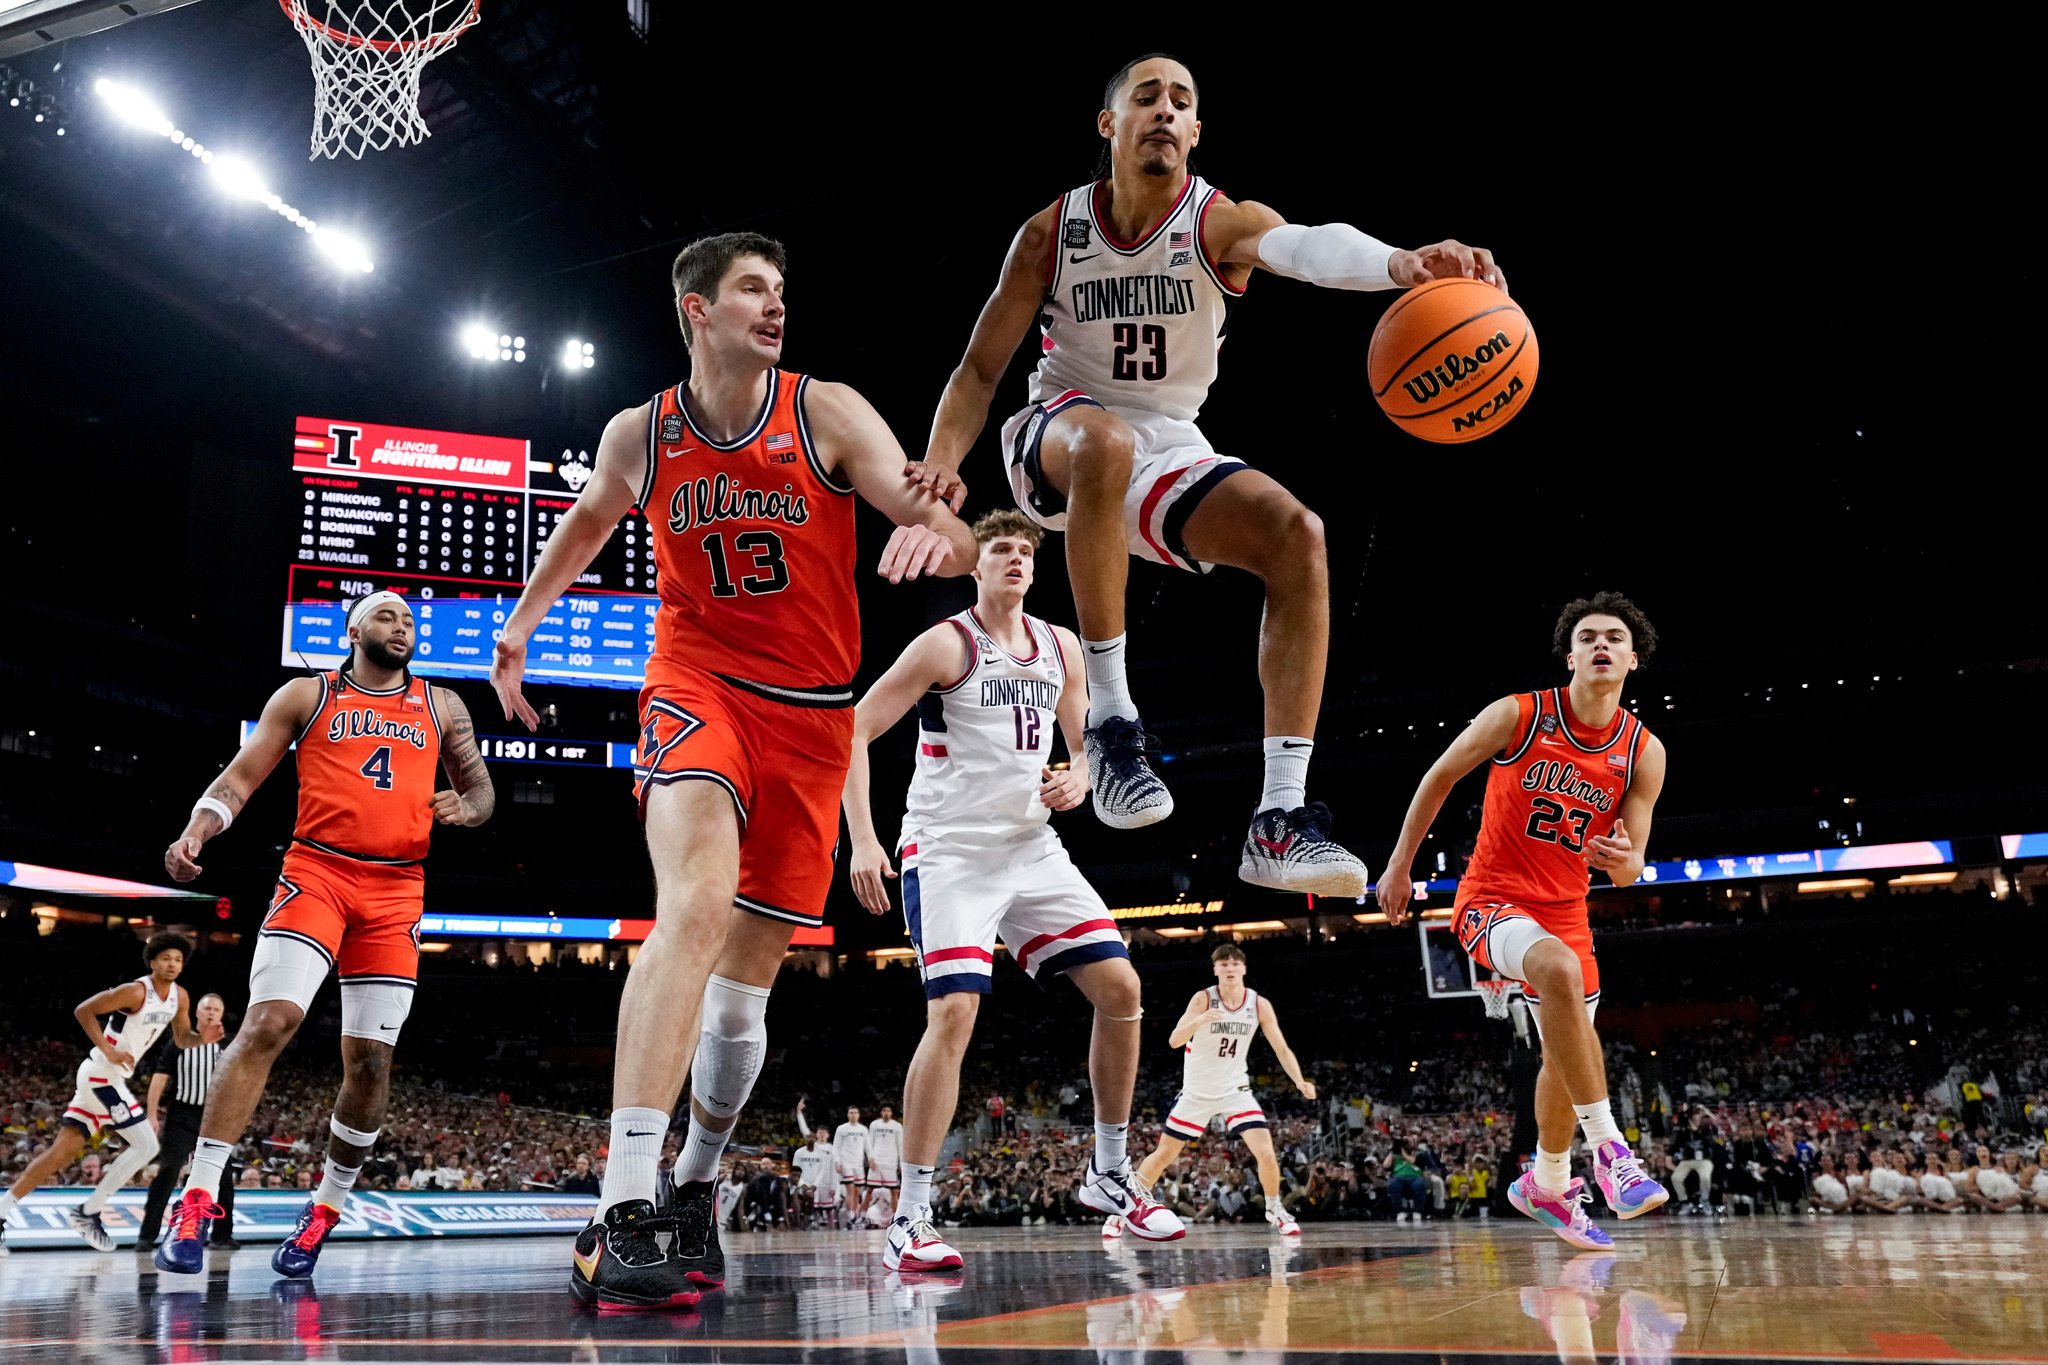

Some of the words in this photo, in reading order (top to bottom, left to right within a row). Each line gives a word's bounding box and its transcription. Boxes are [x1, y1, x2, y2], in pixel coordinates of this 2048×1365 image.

[1170, 257, 1192, 265] EAST
[1072, 275, 1195, 323] CONNECTICUT
[1112, 323, 1167, 381] 23
[1402, 330, 1512, 404] Wilson
[1451, 375, 1524, 433] NCAA
[384, 439, 438, 454] ILLINOIS
[663, 432, 680, 440] FOUR
[371, 448, 459, 471] FIGHTING
[459, 457, 511, 476] ILLINI
[302, 477, 315, 485] ON
[316, 478, 331, 486] THE
[331, 480, 359, 488] COURT
[396, 486, 412, 495] PTS
[305, 490, 315, 500] 0
[322, 491, 381, 507] MIRKOVIC
[420, 501, 431, 511] 0
[442, 503, 453, 513] 0
[463, 505, 474, 515] 0
[487, 507, 493, 518] 1
[506, 509, 516, 519] 0
[668, 472, 809, 534] Illinois
[304, 504, 314, 515] 2
[321, 506, 394, 522] STOJAKOVIC
[441, 517, 452, 528] 0
[463, 519, 474, 530] 0
[485, 521, 495, 532] 0
[506, 523, 516, 534] 0
[303, 519, 313, 530] 4
[320, 521, 376, 536] BOSWELL
[441, 532, 452, 542] 0
[462, 534, 473, 544] 0
[484, 535, 495, 546] 0
[508, 537, 514, 548] 1
[625, 534, 636, 545] 0
[301, 534, 314, 545] 13
[319, 536, 355, 549] IVISIC
[397, 542, 407, 553] 0
[419, 544, 429, 555] 0
[441, 546, 451, 557] 0
[462, 548, 472, 559] 0
[484, 550, 494, 561] 0
[505, 552, 515, 562] 0
[625, 548, 635, 559] 0
[646, 550, 655, 560] 0
[298, 549, 315, 560] 23
[318, 550, 369, 565] WAGLER
[440, 561, 450, 571] 0
[462, 563, 472, 573] 0
[484, 564, 494, 575] 0
[507, 566, 513, 577] 1
[646, 564, 656, 575] 0
[701, 531, 790, 598] 13
[340, 580, 374, 596] 4/13
[421, 587, 434, 600] 0
[497, 593, 503, 605] 1
[646, 578, 656, 589] 0
[421, 605, 433, 618] 2
[492, 611, 505, 624] 0
[569, 599, 599, 613] 7/16
[645, 605, 656, 618] 4
[541, 616, 564, 626] PT%
[571, 617, 591, 630] 67
[645, 623, 655, 635] 3
[419, 642, 432, 655] 0
[570, 635, 592, 648] 30
[569, 653, 592, 667] 100
[981, 680, 1058, 710] CONNECTICUT
[327, 708, 426, 749] Illinois
[1012, 705, 1041, 750] 12
[360, 746, 393, 790] 4
[1521, 759, 1615, 813] Illinois
[1525, 796, 1593, 854] 23
[1109, 902, 1204, 920] NDIANAPOLIS,
[1205, 900, 1224, 913] IN
[1218, 1037, 1238, 1058] 24
[430, 1205, 599, 1222] NCAA.ORG/CHAM
